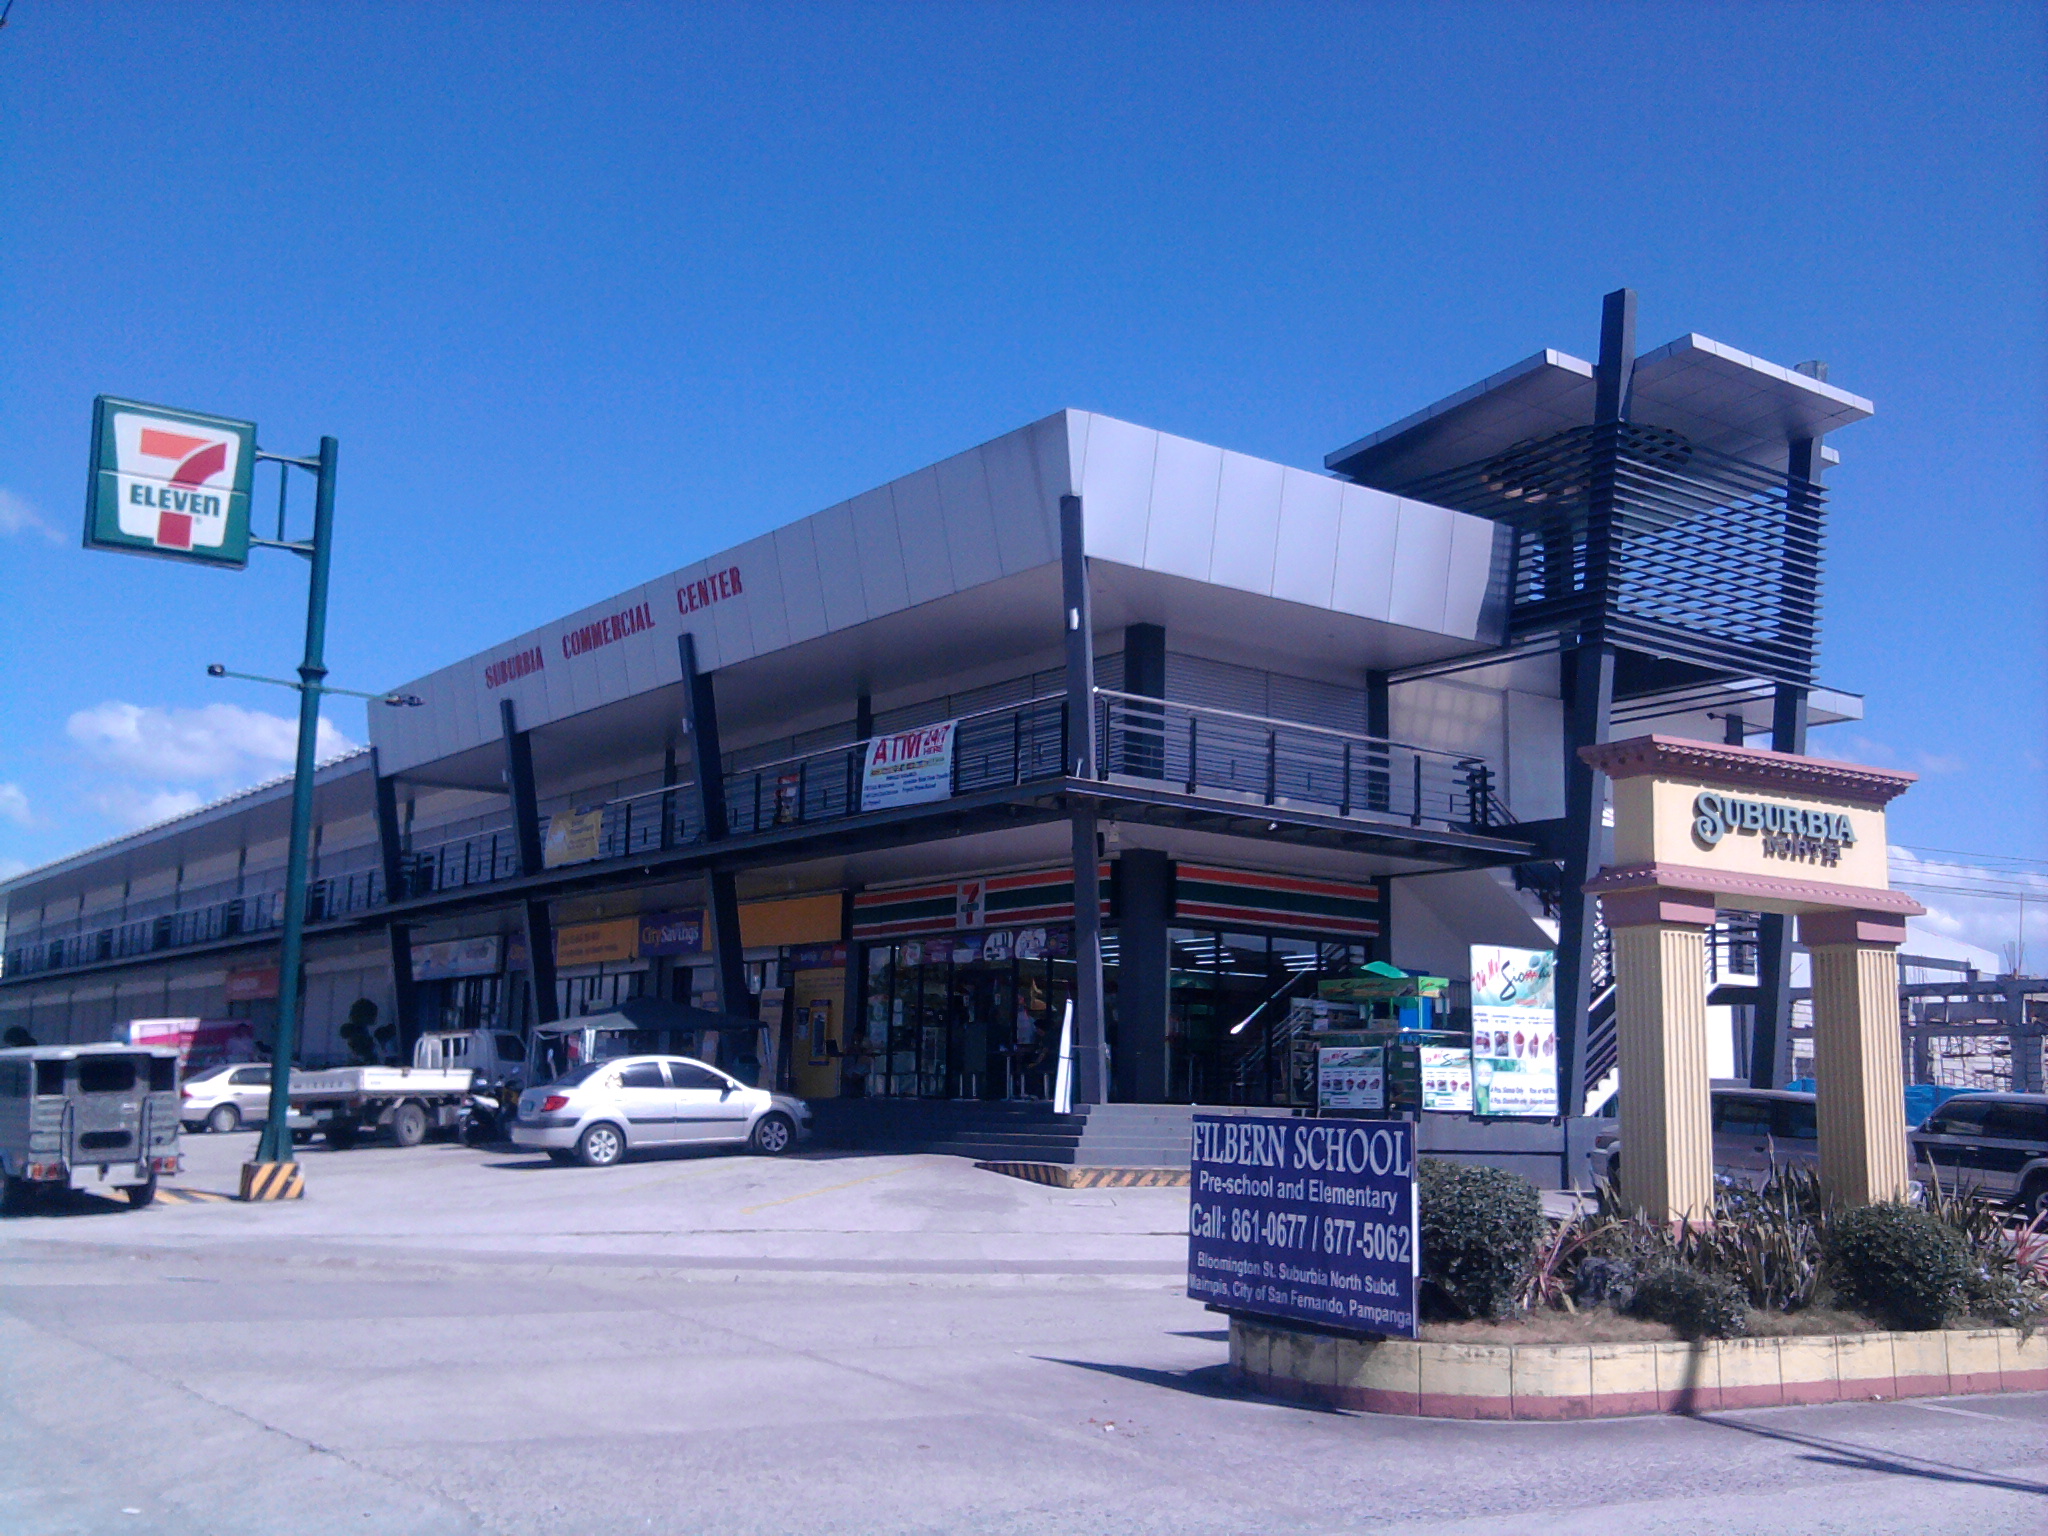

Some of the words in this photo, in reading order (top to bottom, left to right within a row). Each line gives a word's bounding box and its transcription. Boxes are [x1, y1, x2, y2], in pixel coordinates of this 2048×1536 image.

[140, 427, 227, 547] 7
[562, 602, 656, 660] COMMERCIAL
[677, 566, 743, 615] CENTER
[873, 730, 926, 765] ATM
[1695, 791, 1858, 845] SUBURBIA
[1763, 835, 1842, 864] NORTH
[1192, 1121, 1287, 1169] FILBERN
[1293, 1125, 1412, 1178] SCHOOL
[1199, 1170, 1274, 1198] Pre-school
[1277, 1178, 1304, 1200] and
[1309, 1179, 1398, 1215] Elementary
[1191, 1203, 1226, 1240] Call:
[1231, 1208, 1307, 1249] 861-0677
[1324, 1217, 1410, 1263] 877-5062
[1197, 1251, 1260, 1277] Bloomington
[1279, 1263, 1328, 1287] Suburbia
[1330, 1270, 1362, 1292] North
[1364, 1275, 1399, 1297] Subd.
[1232, 1280, 1253, 1302] City
[1255, 1285, 1266, 1301] of
[1268, 1286, 1288, 1304] San
[1291, 1290, 1346, 1317] Fernando,
[1349, 1299, 1412, 1329] Pampanga
